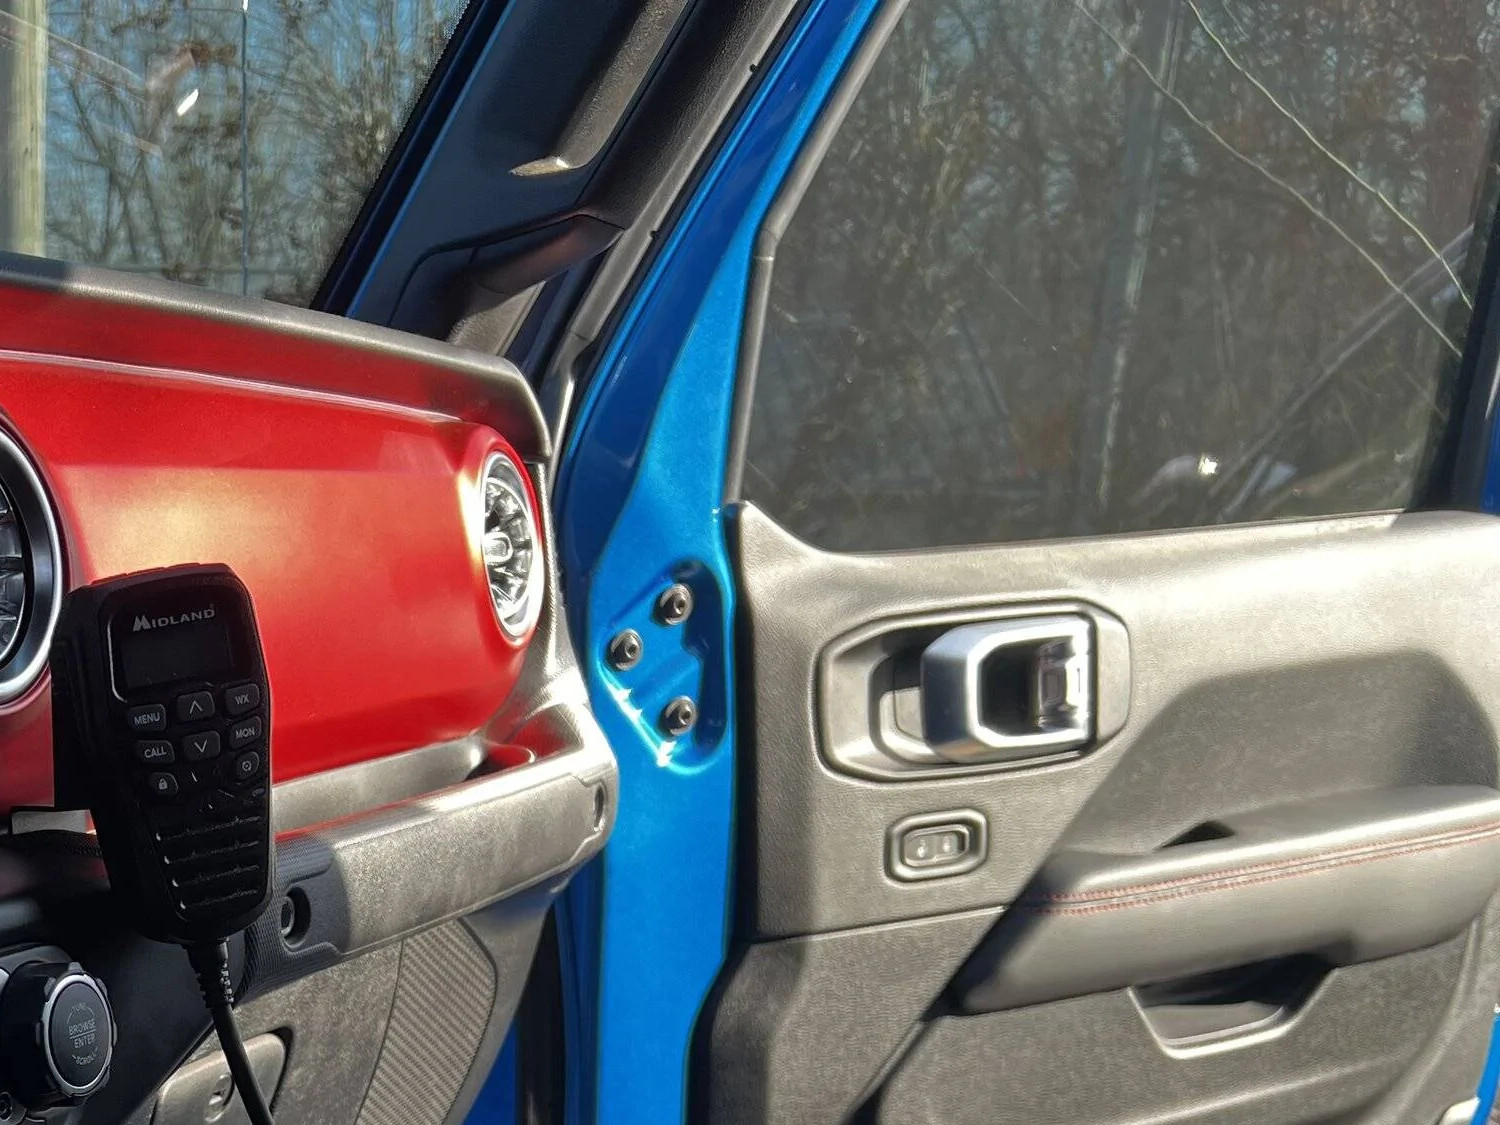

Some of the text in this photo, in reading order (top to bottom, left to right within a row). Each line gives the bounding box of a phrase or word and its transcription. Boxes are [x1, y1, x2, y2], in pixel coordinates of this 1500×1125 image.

[132, 608, 216, 632] MIDLAND
[234, 693, 251, 705] WX
[133, 711, 161, 725] MENU
[235, 727, 256, 739] MON
[143, 745, 168, 759] CALL
[68, 1019, 97, 1036] BROWSE
[74, 1032, 97, 1049] ENTER
